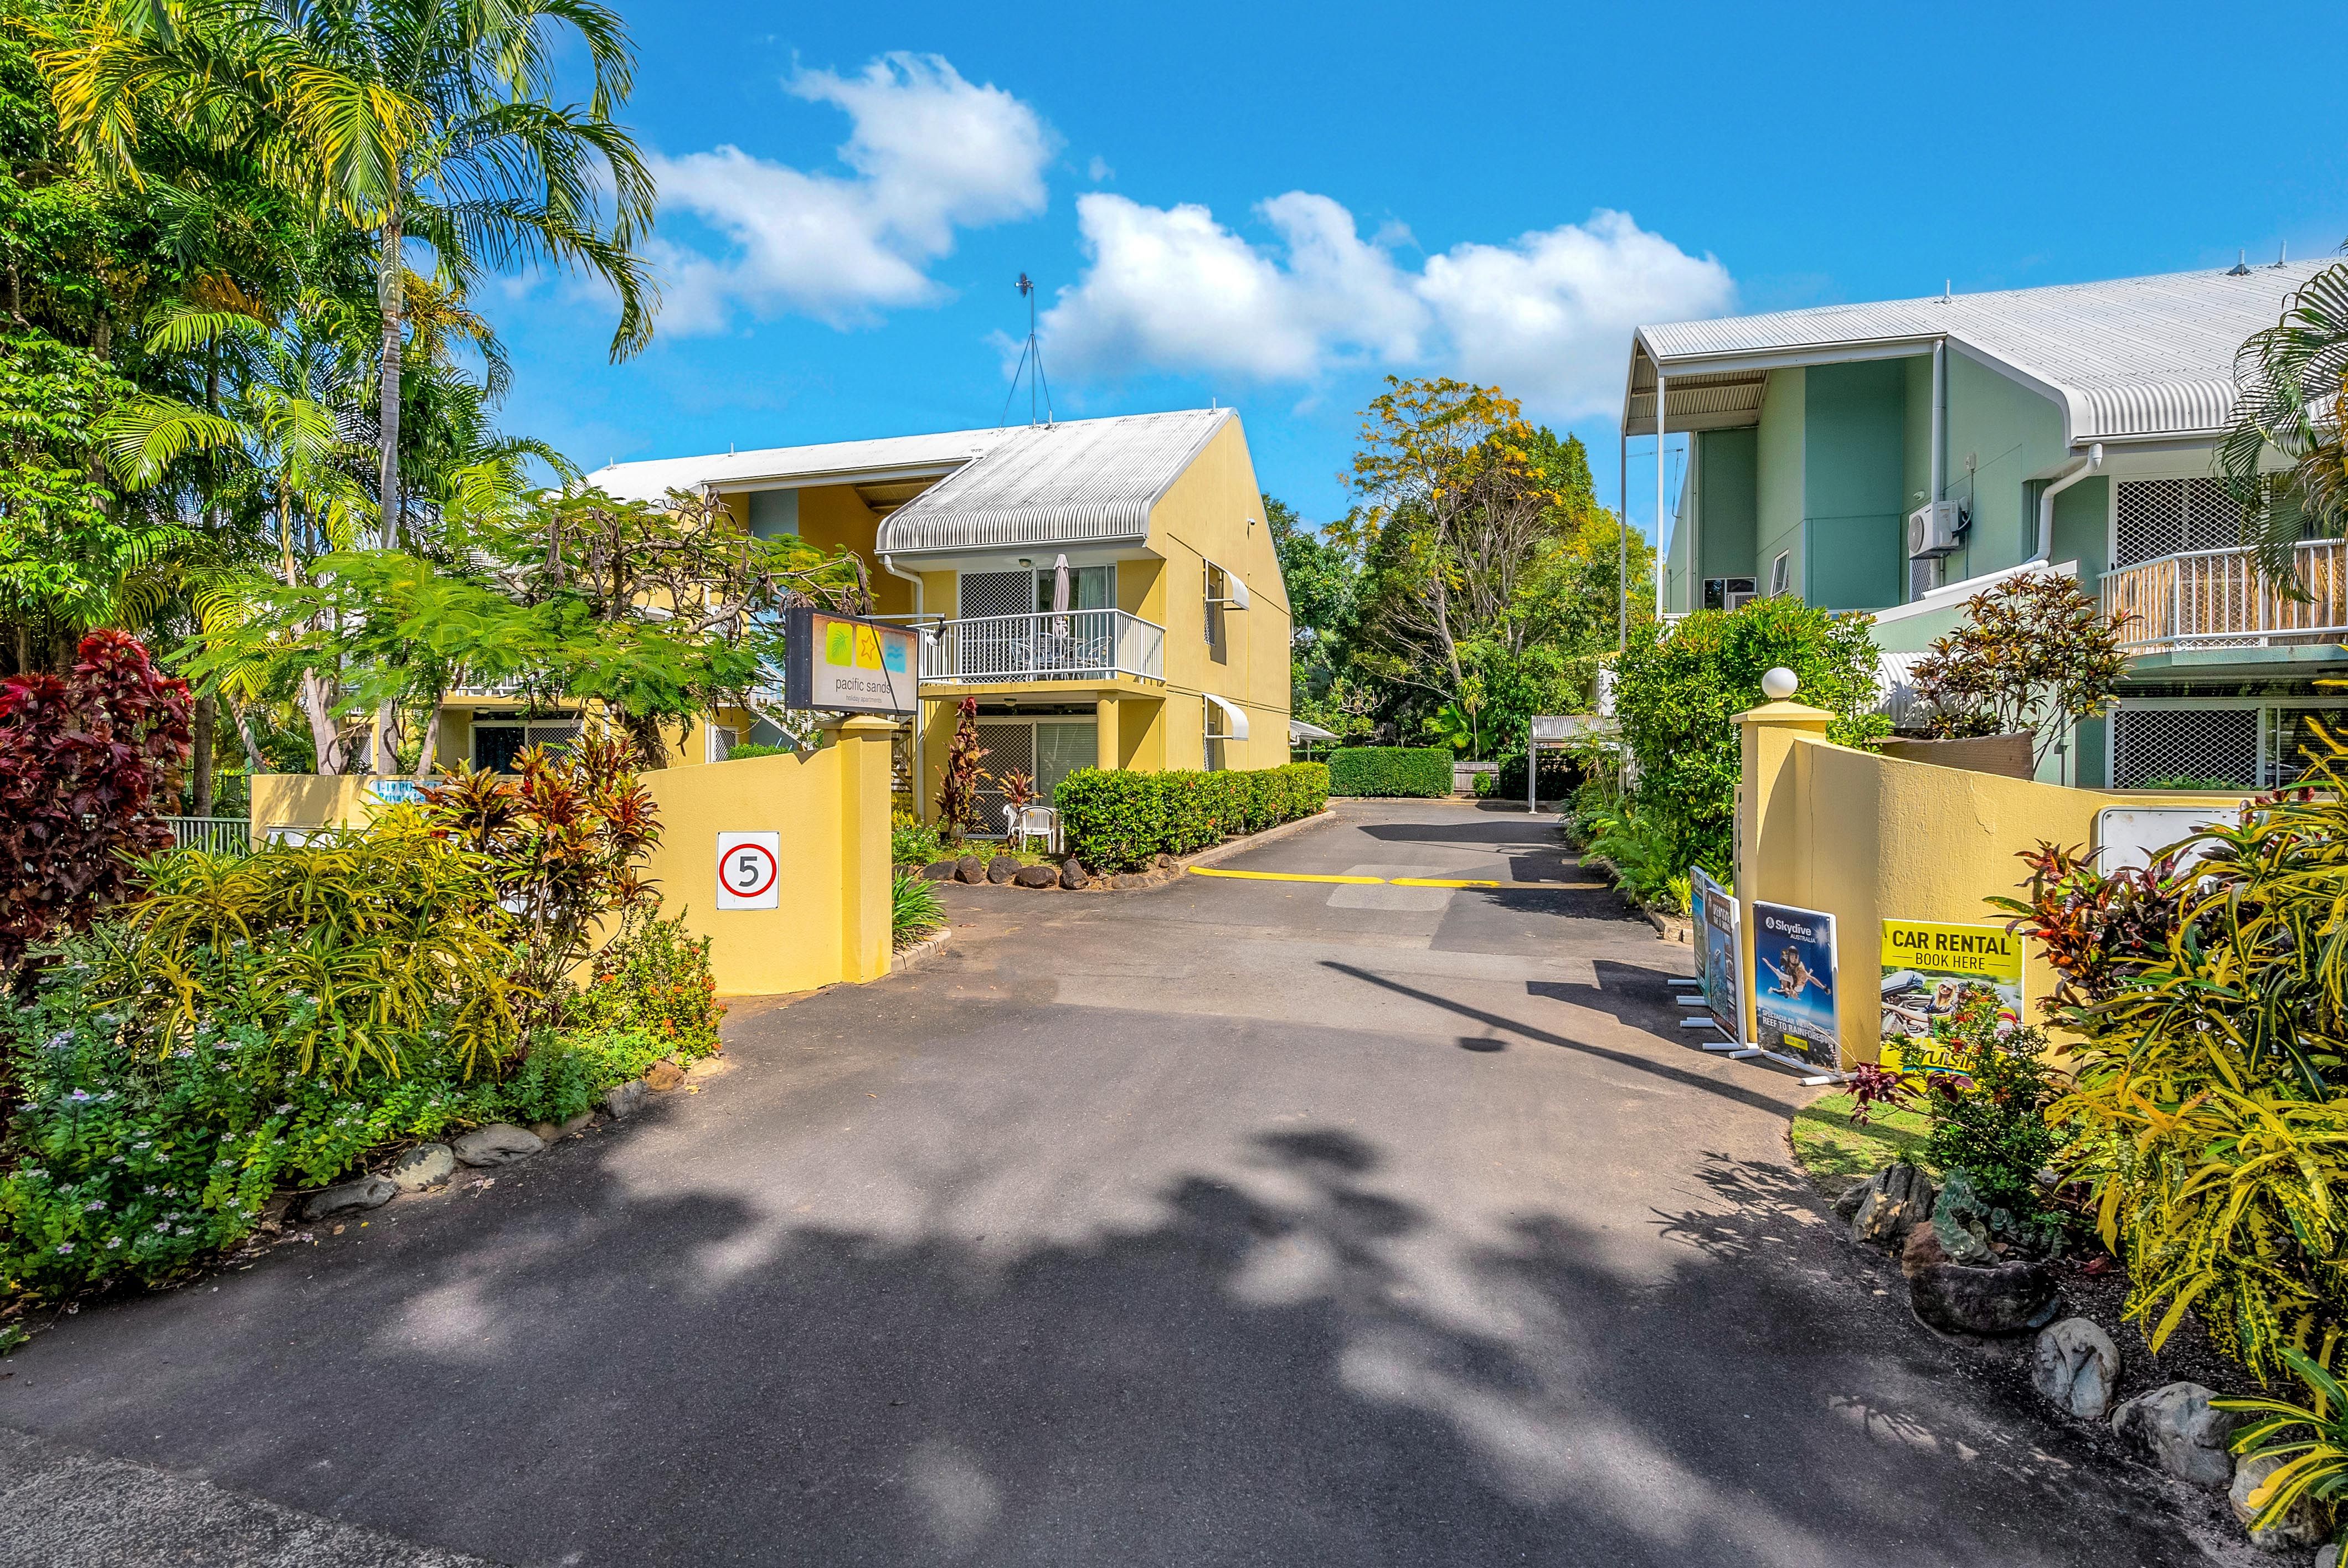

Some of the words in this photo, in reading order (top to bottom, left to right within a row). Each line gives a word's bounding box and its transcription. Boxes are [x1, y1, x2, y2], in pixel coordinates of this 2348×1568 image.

[836, 677, 864, 692] pacific
[867, 681, 890, 694] sands
[846, 694, 859, 703] holiday
[739, 856, 759, 887] 5
[1775, 920, 1811, 936] Skydive
[1790, 933, 1816, 943] AUSTRALIA
[1892, 930, 1929, 950] CAR
[1935, 933, 2011, 956] RENTAL
[1916, 953, 1949, 968] BOOK
[1953, 956, 1985, 970] HERE
[1762, 1009, 1794, 1024] SPECTACULAR
[1763, 1017, 1778, 1028] REEF
[1778, 1021, 1787, 1031] TO
